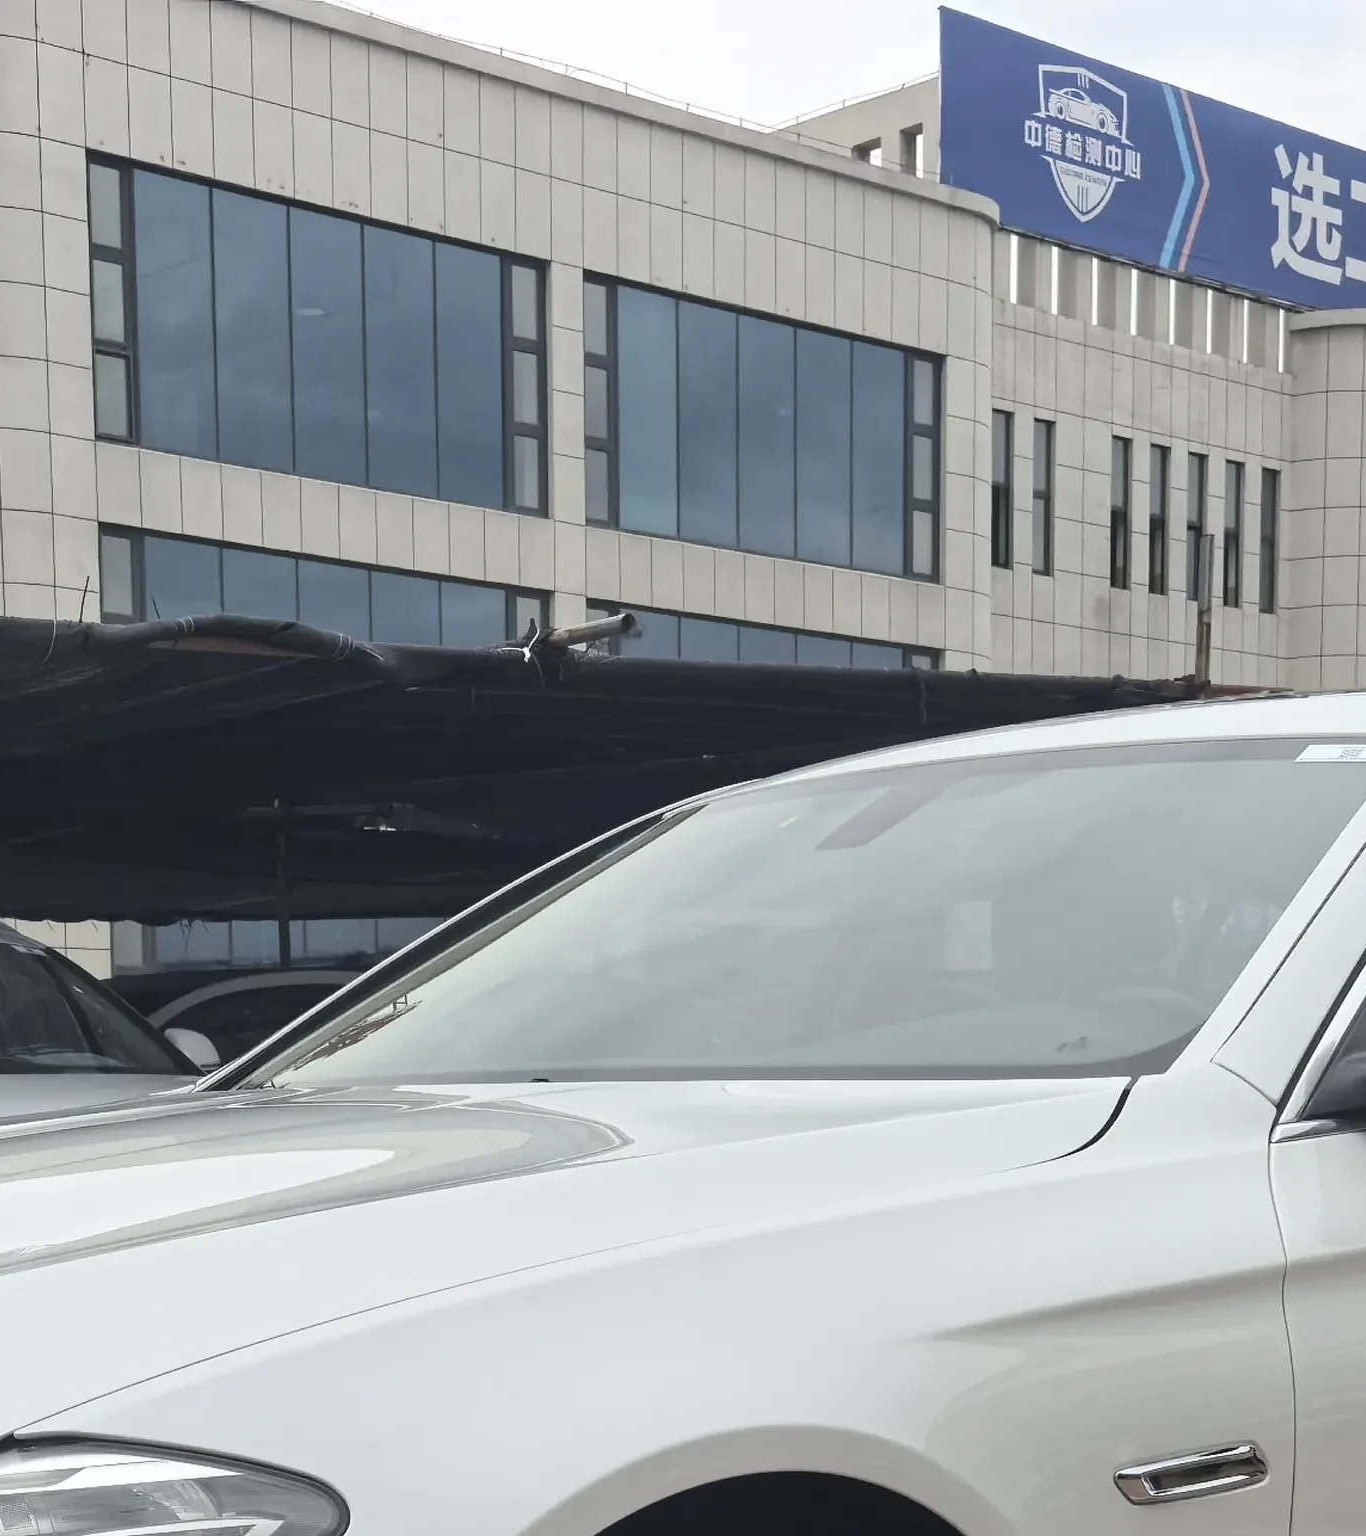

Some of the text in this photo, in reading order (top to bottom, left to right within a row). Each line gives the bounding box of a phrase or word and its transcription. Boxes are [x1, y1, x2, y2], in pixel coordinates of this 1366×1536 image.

[1023, 119, 1142, 180] 中德检测中心
